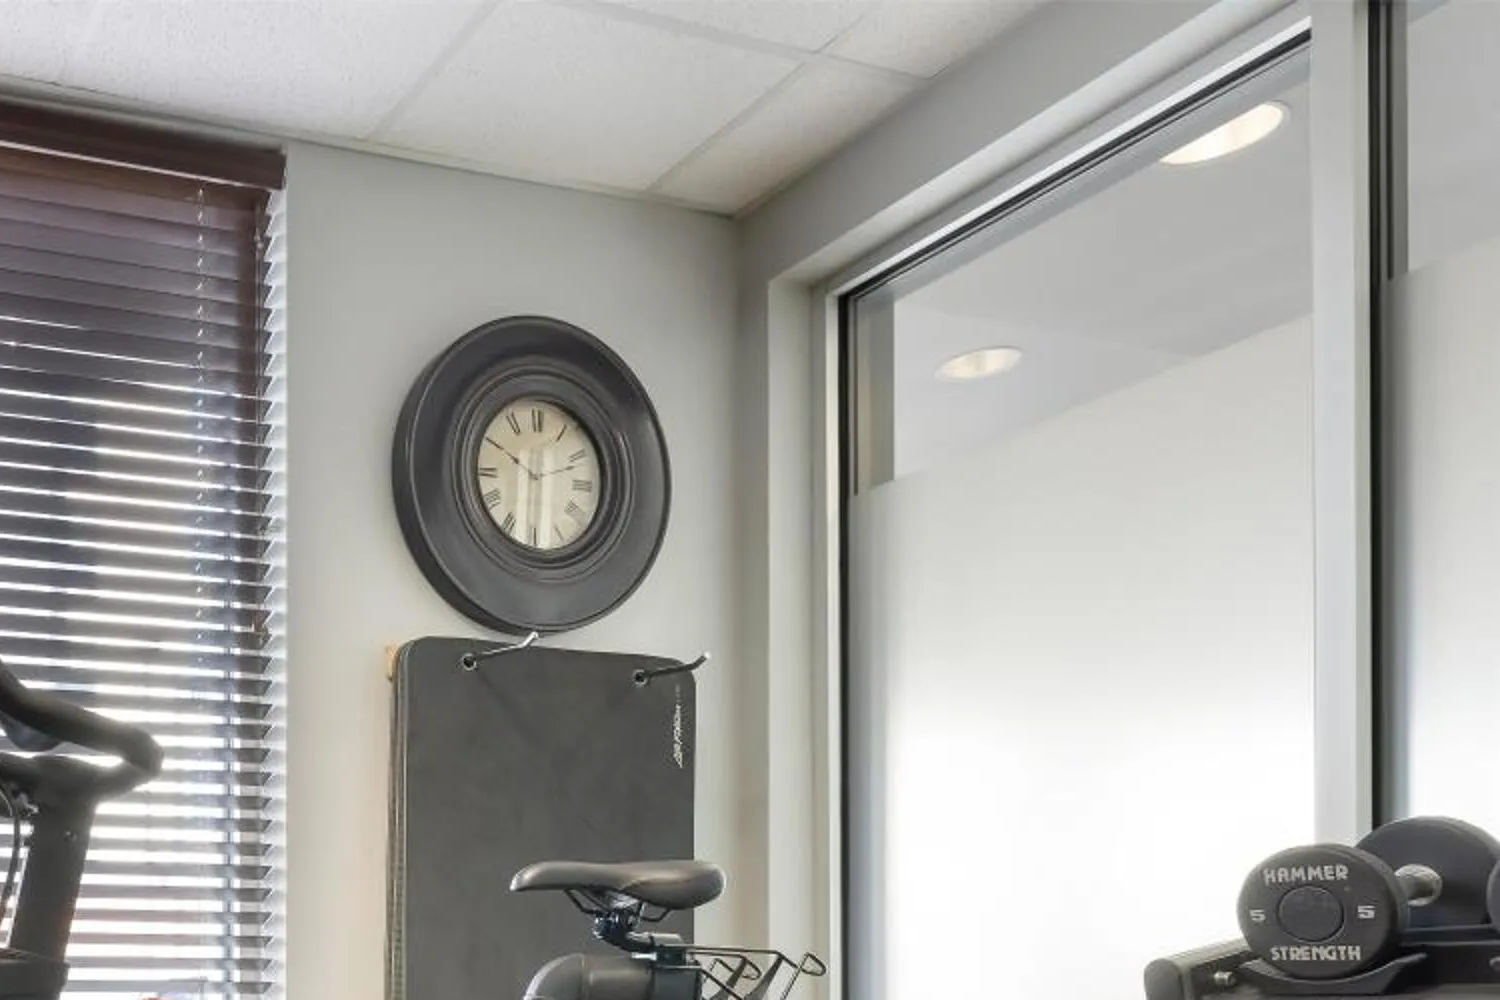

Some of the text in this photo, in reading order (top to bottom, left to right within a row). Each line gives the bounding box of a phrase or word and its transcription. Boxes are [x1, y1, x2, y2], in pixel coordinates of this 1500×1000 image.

[1263, 863, 1349, 886] HAMMER
[1250, 904, 1377, 923] 5 5
[1270, 945, 1362, 962] STRENGTH
